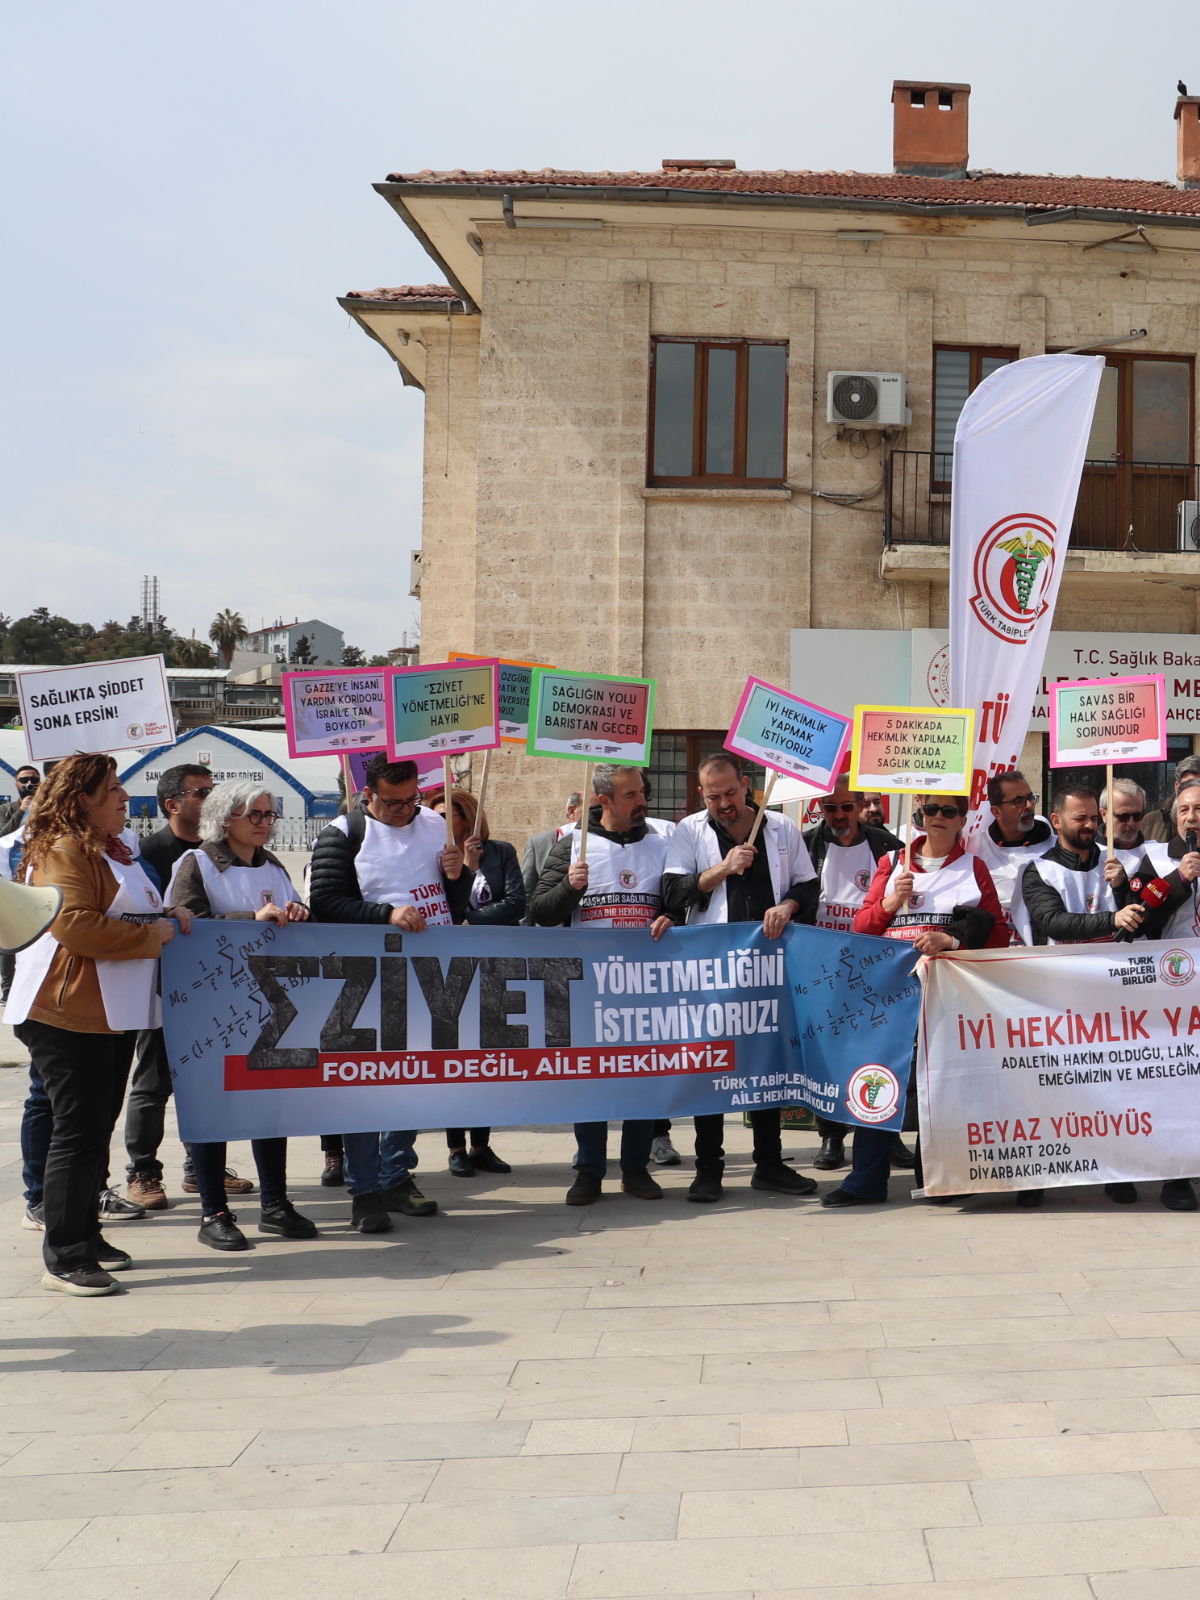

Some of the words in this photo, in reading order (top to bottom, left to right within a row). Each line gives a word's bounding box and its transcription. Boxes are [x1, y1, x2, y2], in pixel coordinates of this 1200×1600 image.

[978, 599, 998, 623] TÜRK
[1073, 649, 1104, 664] T.C.
[1108, 650, 1158, 669] Sağlık
[30, 687, 95, 708] SAĞLIKTA
[98, 677, 144, 699] ŞİDDET
[305, 682, 348, 694] GAZZE'YE
[351, 678, 379, 691] İNSANİ
[552, 685, 604, 701] SAĞLIĞIN
[608, 691, 637, 705] YOLU
[300, 696, 335, 707] YARDIM
[1079, 693, 1115, 707] SAVAŞ
[1118, 690, 1135, 704] BİR
[33, 713, 72, 731] SONA
[75, 704, 119, 725] ERSİN!
[316, 707, 349, 719] İSRAİL'E
[352, 706, 372, 716] TAM
[430, 713, 460, 727] HAYIR
[552, 701, 616, 718] DEMOKRASİ
[620, 709, 633, 720] VE
[765, 697, 780, 713] İYİ
[781, 706, 828, 734] HEKİMLİK
[1070, 710, 1097, 723] HALK
[1101, 706, 1146, 721] SAĞLIĞI
[325, 720, 366, 732] BOYKOT!
[545, 715, 598, 731] BARIŞTAN
[601, 722, 639, 736] GEÇER
[771, 717, 814, 743] YAPMAK
[886, 719, 893, 729] 5
[896, 719, 943, 731] DAKİKADA
[1076, 723, 1140, 738] SORUNUDUR
[761, 726, 814, 758] İSTİYORUZ
[867, 731, 908, 742] HEKİMLİK
[912, 733, 960, 745] YAPILMAZ,
[884, 745, 892, 754] 5
[894, 745, 941, 756] DAKİKADA
[877, 757, 910, 768] SAĞLIK
[914, 759, 947, 770] OLMAZ
[409, 882, 443, 902] TÜRK
[607, 893, 620, 903] BİR
[621, 893, 646, 904] SAĞLIK
[604, 906, 617, 917] BİR
[906, 914, 931, 925] SAĞLIK
[1127, 956, 1155, 966] TÜRK
[592, 948, 784, 995] YÖNETMELİĞİNİ
[1108, 965, 1156, 977] TABİPLERİ
[1122, 974, 1157, 986] BİRLİĞİ
[594, 998, 779, 1043] İSTEMİYORUZ!
[957, 1013, 996, 1051] İYİ
[1006, 1005, 1150, 1049] HEKİMLİK
[322, 1055, 437, 1082] FORMÜL
[443, 1054, 529, 1080] DEĞİL,
[534, 1051, 592, 1076] AİLE
[599, 1044, 729, 1074] HEKİMİYİZ
[1001, 1052, 1060, 1069] ADALETİN
[1063, 1049, 1104, 1067] HAKİM
[1108, 1045, 1164, 1064] OLDUĞU,
[1167, 1042, 1199, 1060] LAİK,
[712, 1075, 749, 1091] TÜRK
[750, 1071, 807, 1087] TABİPLERİ
[807, 1077, 840, 1099] BİRLİĞİ
[1038, 1066, 1112, 1086] EMEĞİMİZİN
[1117, 1067, 1132, 1082] VE
[730, 1090, 761, 1106] AİLE
[763, 1086, 811, 1104] HEKİMLİĞİ
[811, 1095, 836, 1114] KOLU
[967, 1117, 1042, 1145] BEYAZ
[1050, 1108, 1153, 1137] YÜRÜYÜŞ
[968, 1149, 994, 1162] 11-14
[998, 1145, 1034, 1160] MART
[1038, 1143, 1071, 1157] 2026
[969, 1158, 1099, 1180] DİYARBAKIR-ANKARA
